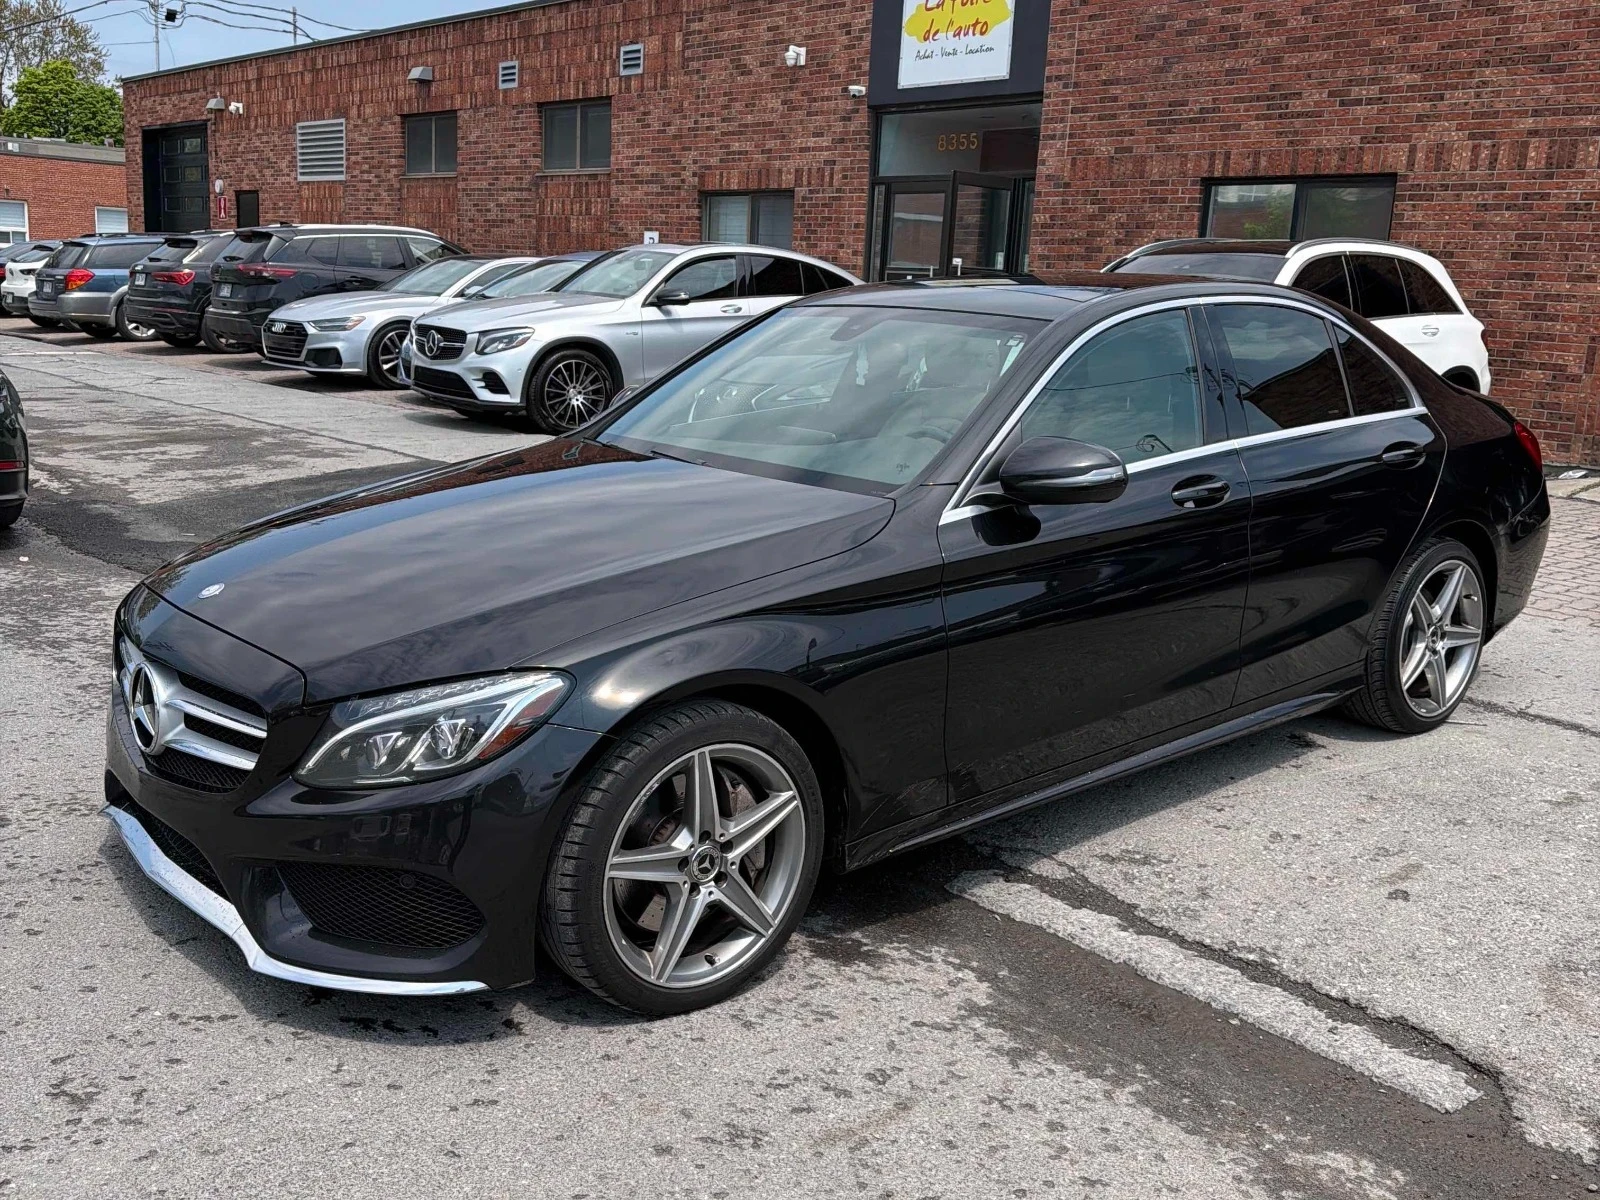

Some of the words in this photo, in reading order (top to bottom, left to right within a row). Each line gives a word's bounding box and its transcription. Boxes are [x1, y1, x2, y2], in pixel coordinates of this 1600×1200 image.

[923, 18, 940, 43] de
[946, 17, 989, 40] l'auto
[914, 49, 934, 61] Achat
[940, 46, 958, 58] Vente
[965, 43, 995, 55] Location
[937, 132, 978, 151] 8355
